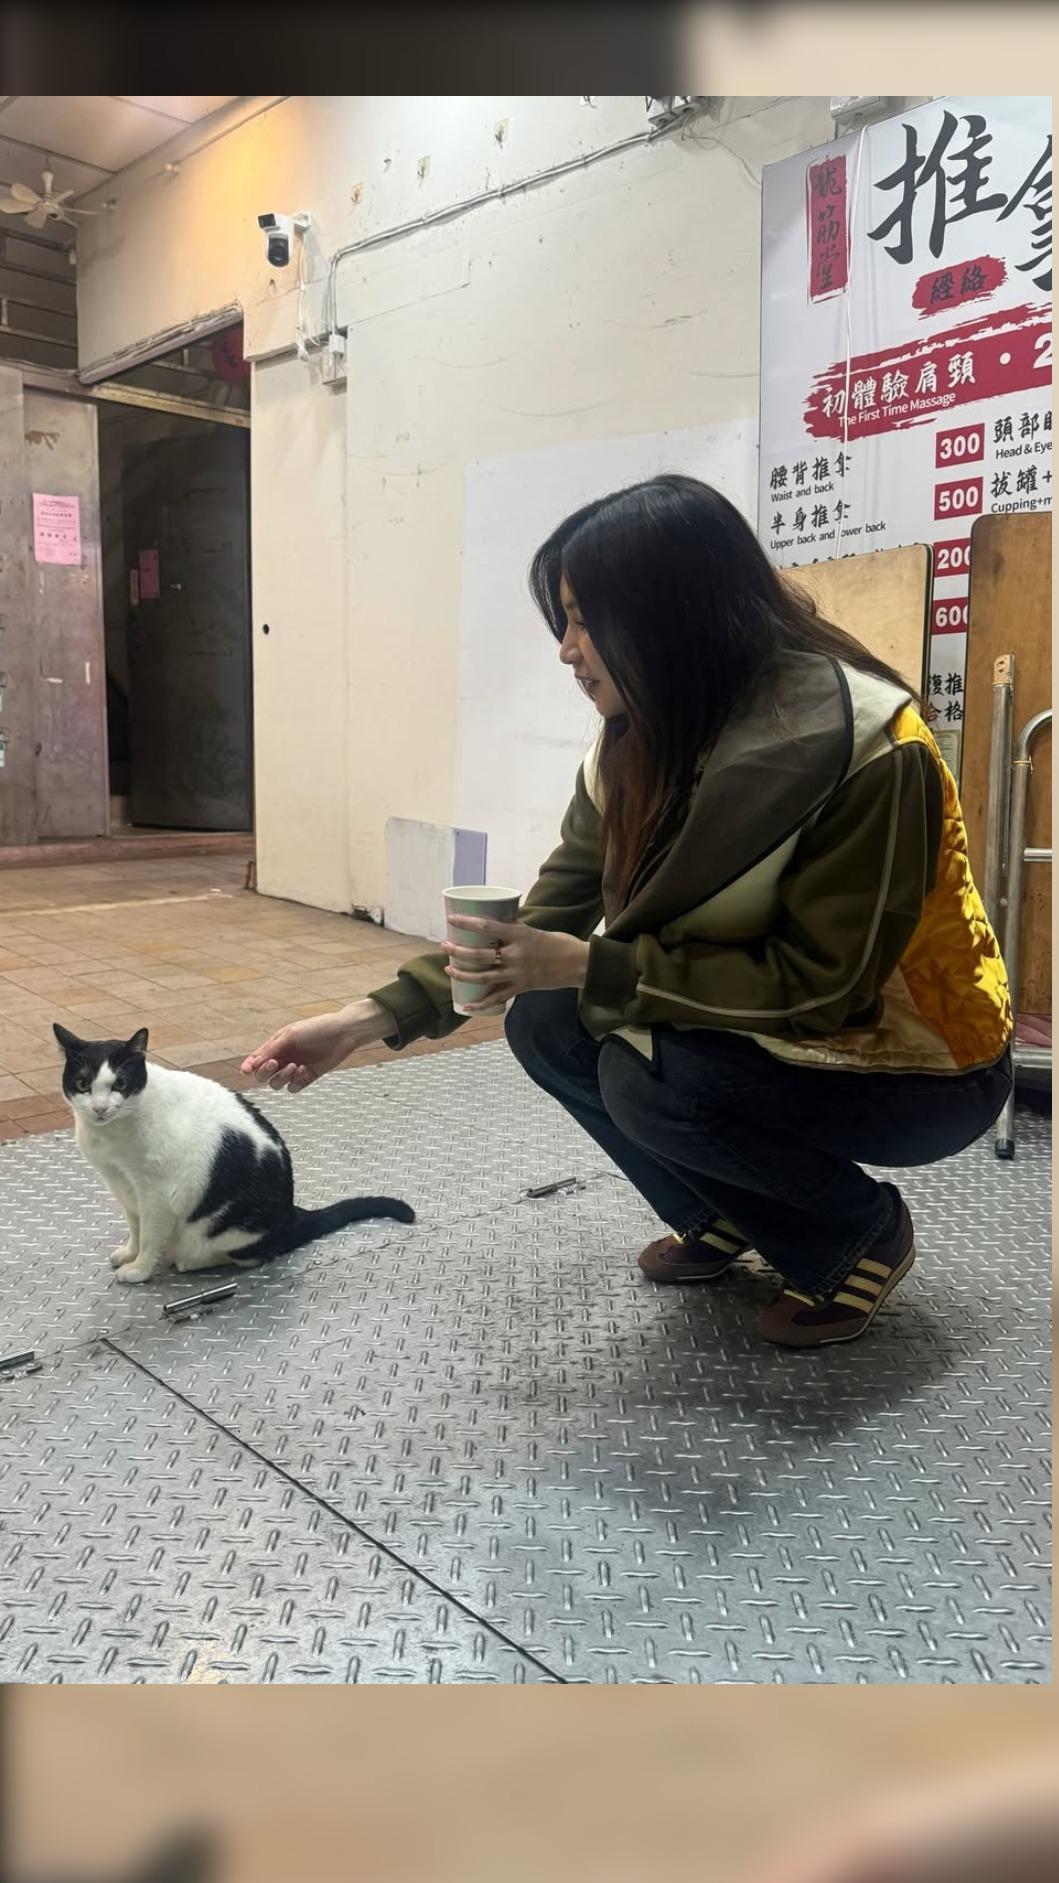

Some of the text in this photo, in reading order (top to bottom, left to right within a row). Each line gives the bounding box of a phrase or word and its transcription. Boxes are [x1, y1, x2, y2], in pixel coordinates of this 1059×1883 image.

[930, 265, 989, 304] 經絡
[838, 393, 956, 428] The First Time Massage
[940, 432, 980, 460] 300
[995, 445, 1022, 460] Head
[1024, 443, 1033, 454] &
[771, 481, 834, 502] Waist and back
[938, 486, 979, 512] 500
[770, 538, 794, 550] Upper
[796, 533, 816, 545] back
[819, 529, 835, 541] and
[865, 520, 886, 534] back
